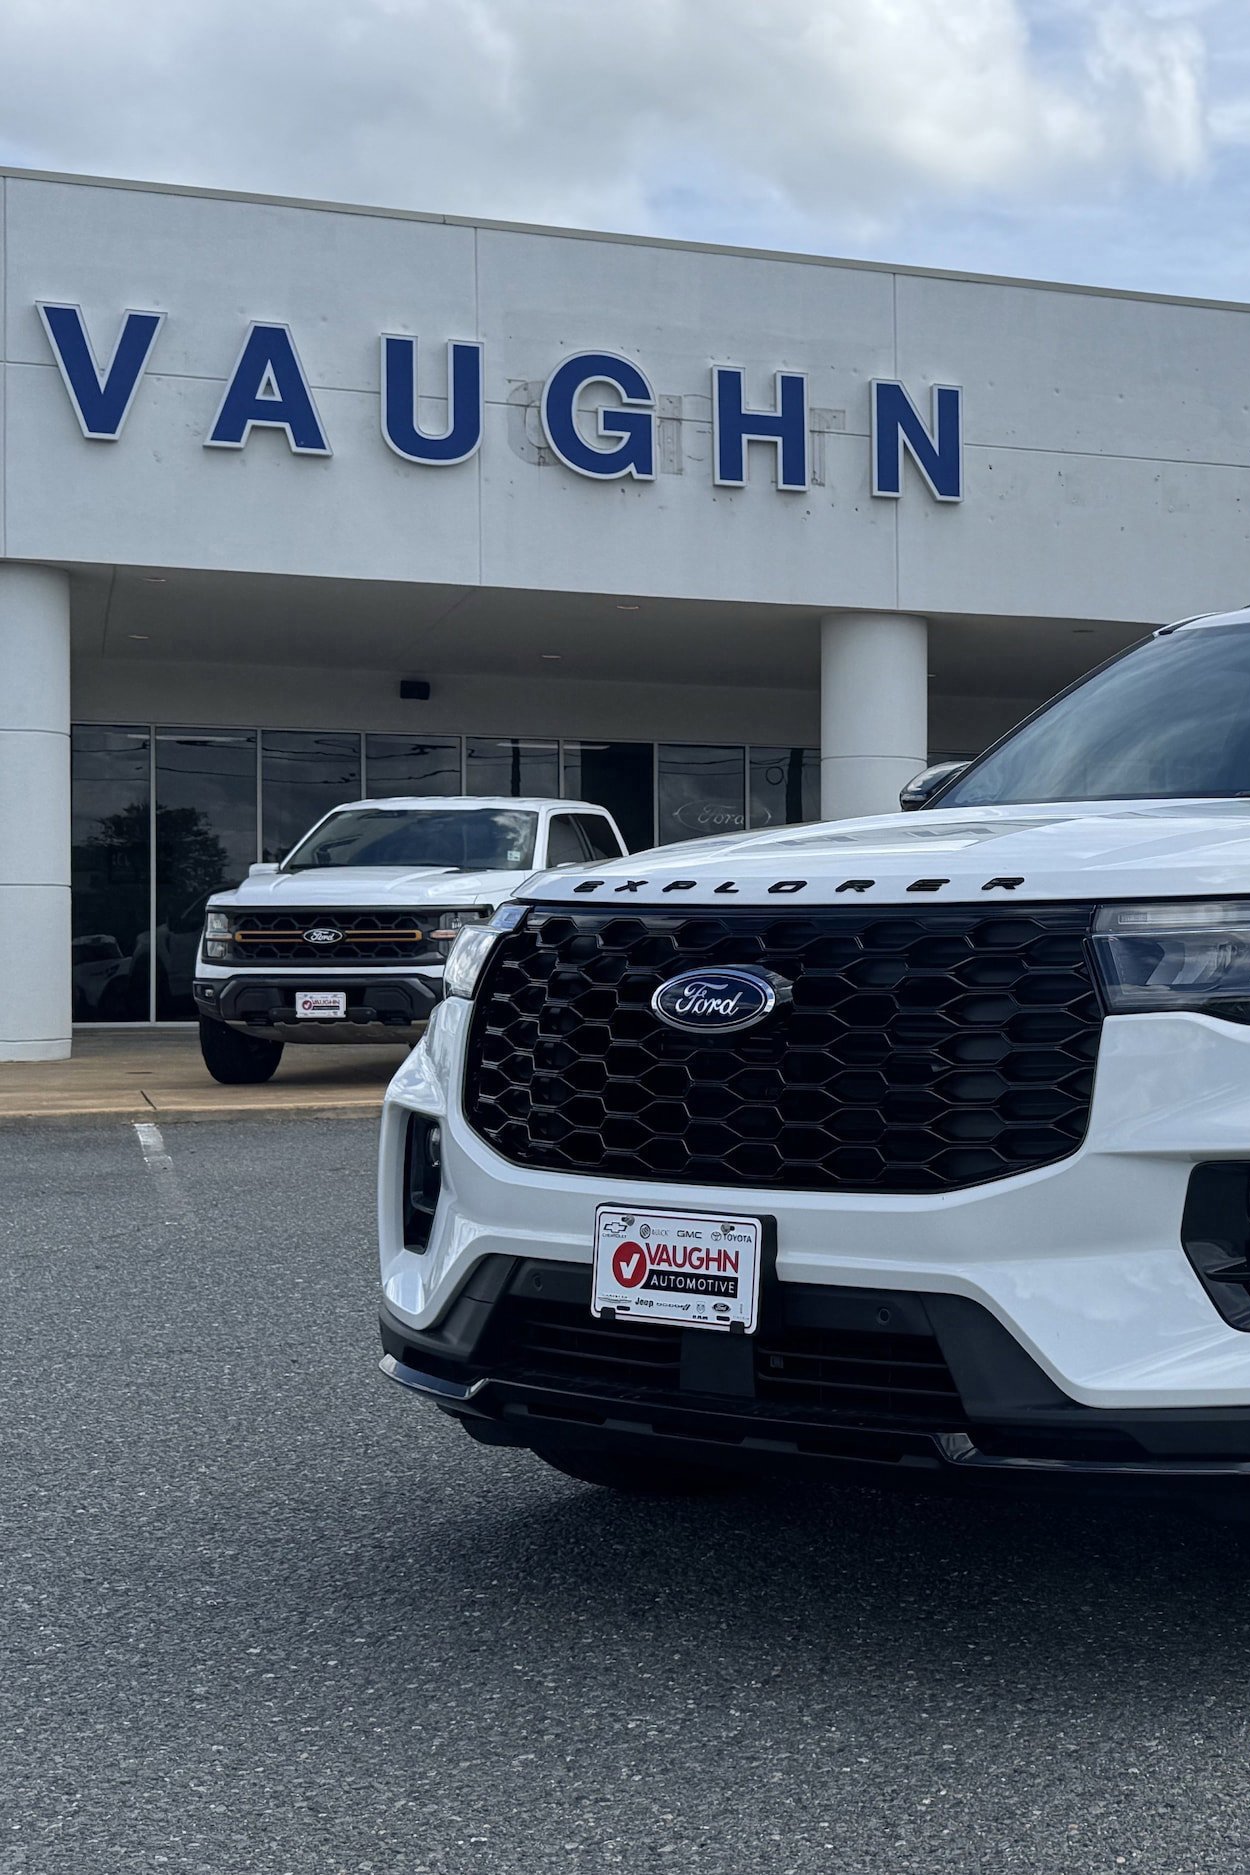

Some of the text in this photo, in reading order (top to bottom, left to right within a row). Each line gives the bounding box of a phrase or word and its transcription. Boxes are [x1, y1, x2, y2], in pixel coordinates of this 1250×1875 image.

[35, 301, 966, 503] VAUGHN
[573, 876, 1025, 894] EXPLORER
[675, 981, 743, 1016] Ford
[677, 1230, 702, 1239] GMC
[722, 1233, 752, 1243] TOYOTA
[645, 1243, 739, 1274] VAUGHN
[650, 1274, 735, 1294] AUTOMOTIVE
[635, 1297, 654, 1308] Jeep
